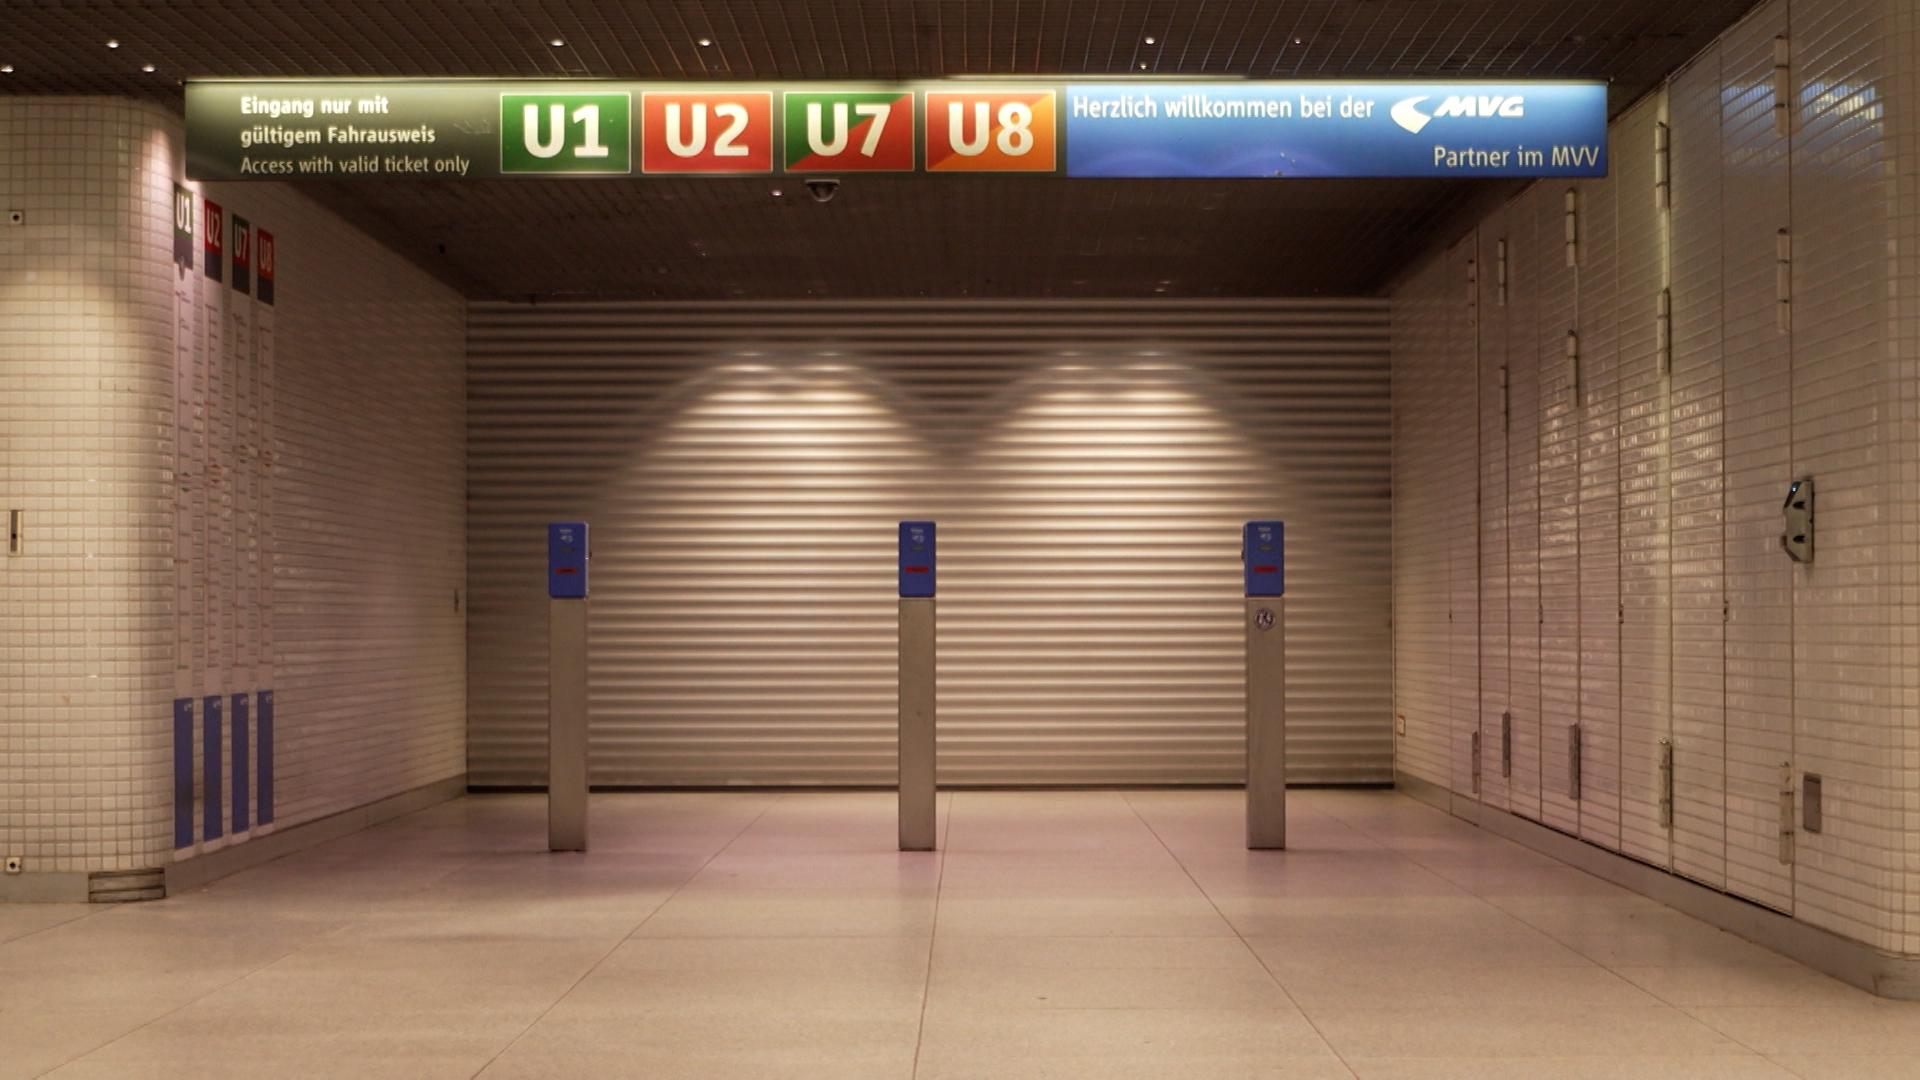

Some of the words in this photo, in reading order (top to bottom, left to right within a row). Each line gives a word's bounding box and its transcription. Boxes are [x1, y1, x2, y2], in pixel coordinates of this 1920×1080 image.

[240, 96, 315, 118] Eingang
[320, 97, 351, 114] nur
[358, 96, 389, 114] mit
[1072, 96, 1157, 118] Herzlich
[1164, 96, 1292, 118] willkommen
[1300, 95, 1332, 118] bei
[1339, 96, 1375, 118] der
[1434, 96, 1524, 117] MVG
[240, 125, 321, 147] gültigem
[327, 126, 436, 143] Fahrausweis
[523, 104, 609, 158] U1
[665, 102, 749, 157] U2
[806, 103, 891, 158] U7
[948, 102, 1034, 157] U8
[240, 157, 294, 174] Access
[299, 156, 333, 173] with
[339, 156, 379, 173] valid
[385, 156, 429, 173] ticket
[434, 156, 470, 176] only
[1433, 145, 1510, 168] Partner
[1517, 145, 1543, 167] im
[1551, 146, 1600, 167] MVV
[176, 192, 191, 233] U1
[206, 208, 220, 248] U2
[234, 223, 247, 260] U7
